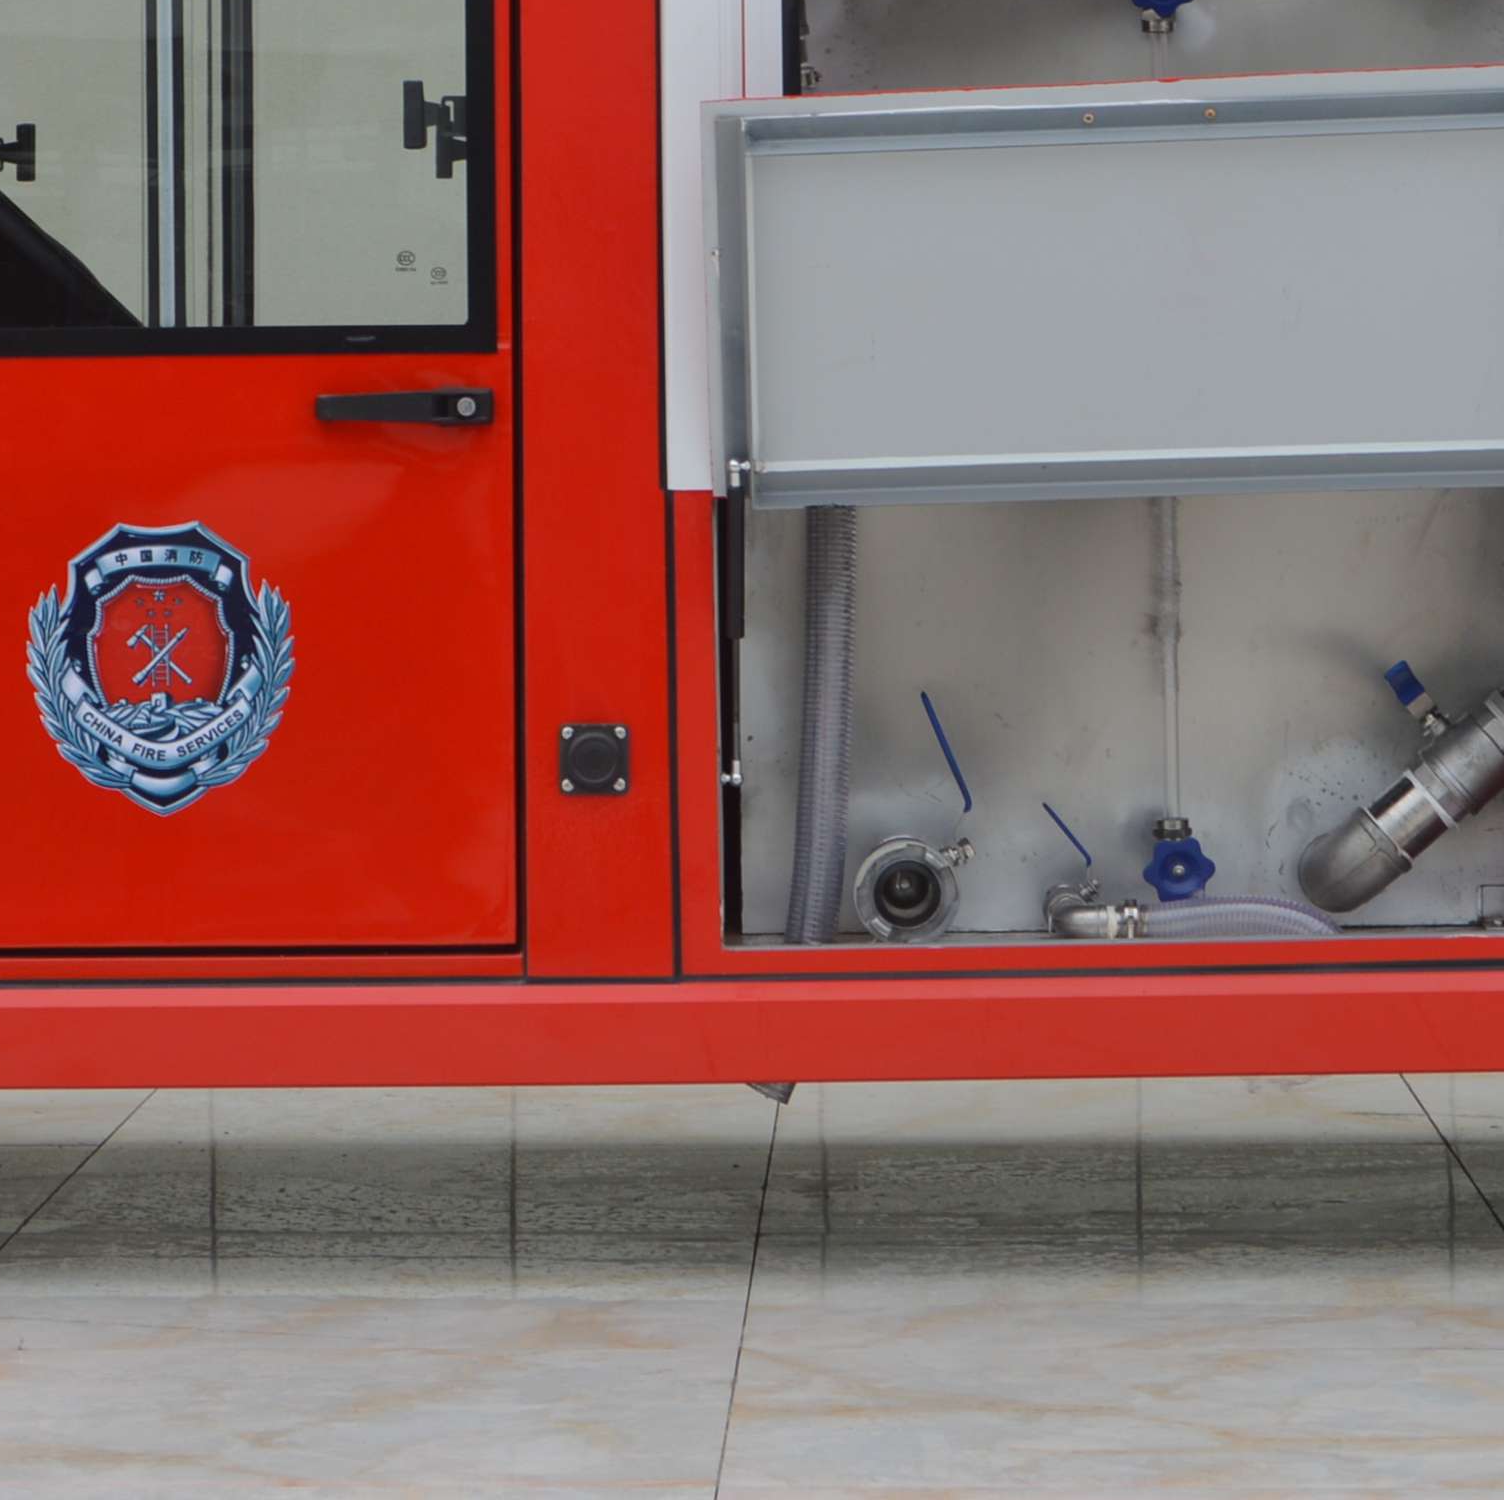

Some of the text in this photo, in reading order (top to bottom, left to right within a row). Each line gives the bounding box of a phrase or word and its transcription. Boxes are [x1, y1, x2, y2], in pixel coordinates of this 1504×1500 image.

[114, 548, 203, 567] 中国消防
[82, 709, 244, 761] CHINA FIRE SERVICES
